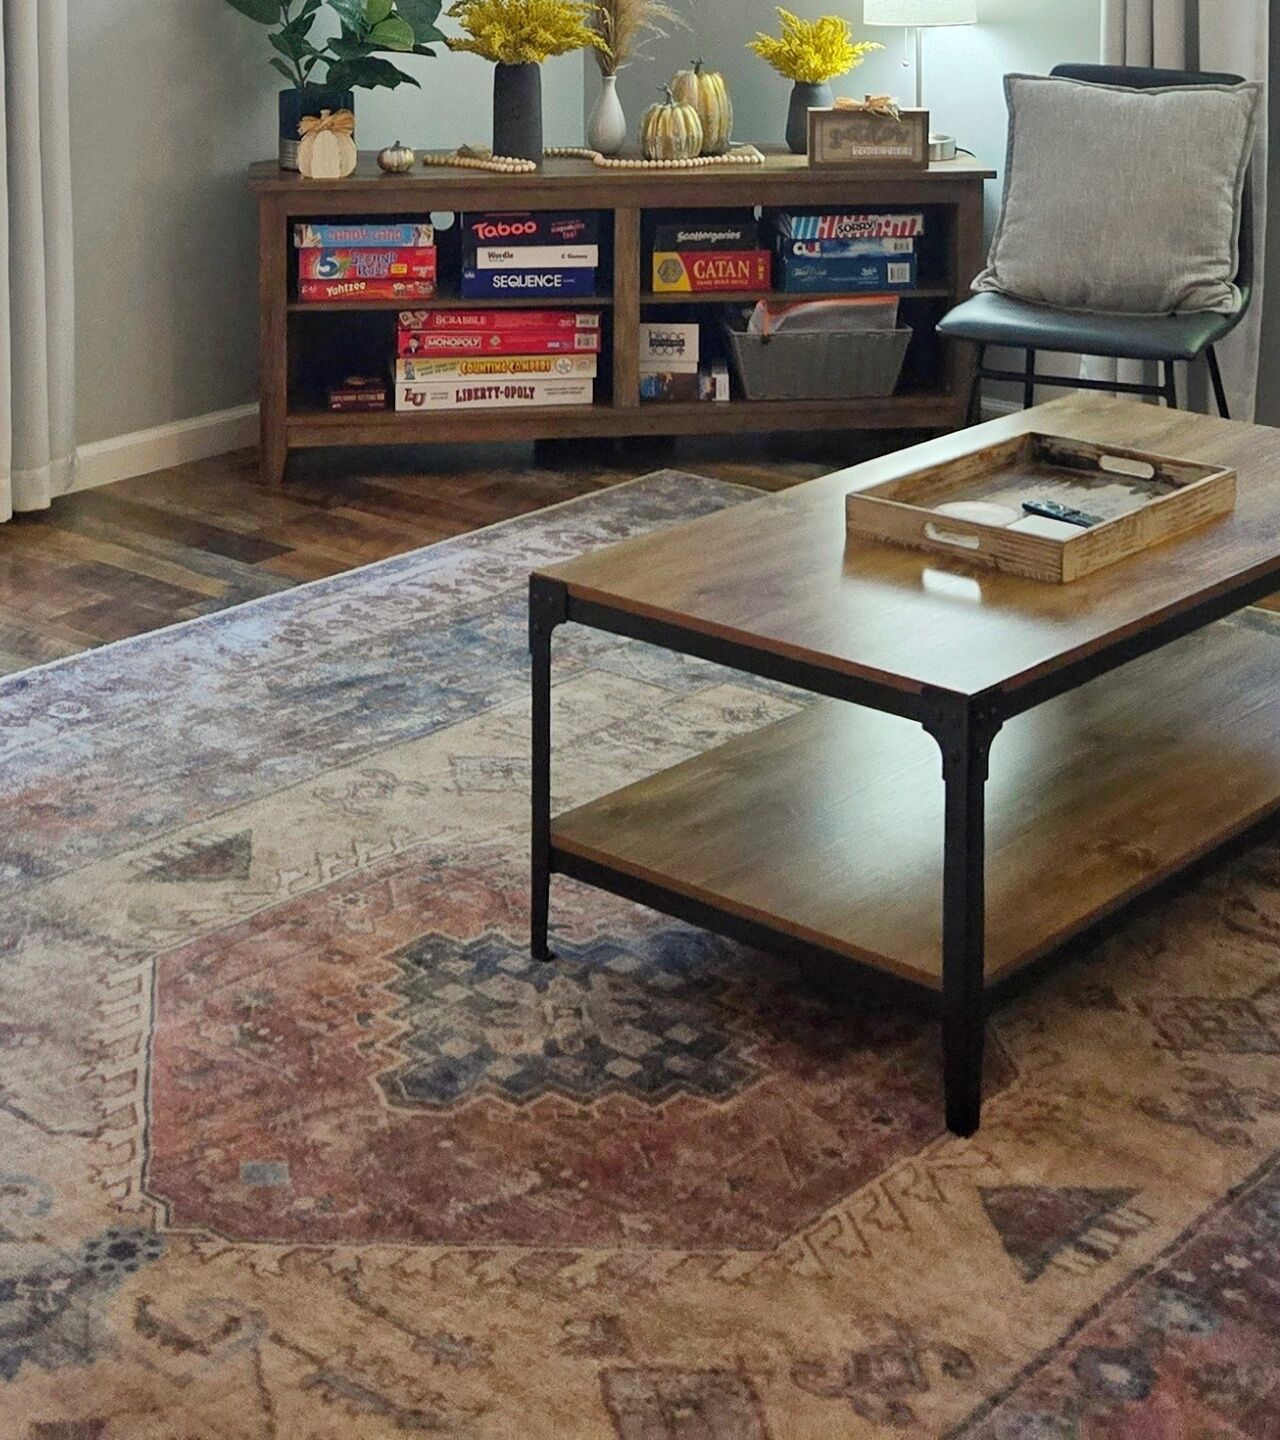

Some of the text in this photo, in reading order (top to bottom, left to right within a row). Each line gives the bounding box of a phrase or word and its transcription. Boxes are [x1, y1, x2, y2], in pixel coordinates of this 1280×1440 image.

[472, 221, 537, 240] Taboo
[676, 229, 741, 242] Scattergories
[693, 260, 750, 279] CATAN
[326, 280, 366, 296] Yahtzee
[493, 274, 562, 288] SEQUENCE
[435, 314, 487, 325] SCRABBLE
[426, 337, 480, 348] MONOPOLY
[460, 360, 509, 375] COUNTING
[455, 386, 535, 403] LIBERTY-OPOLY
